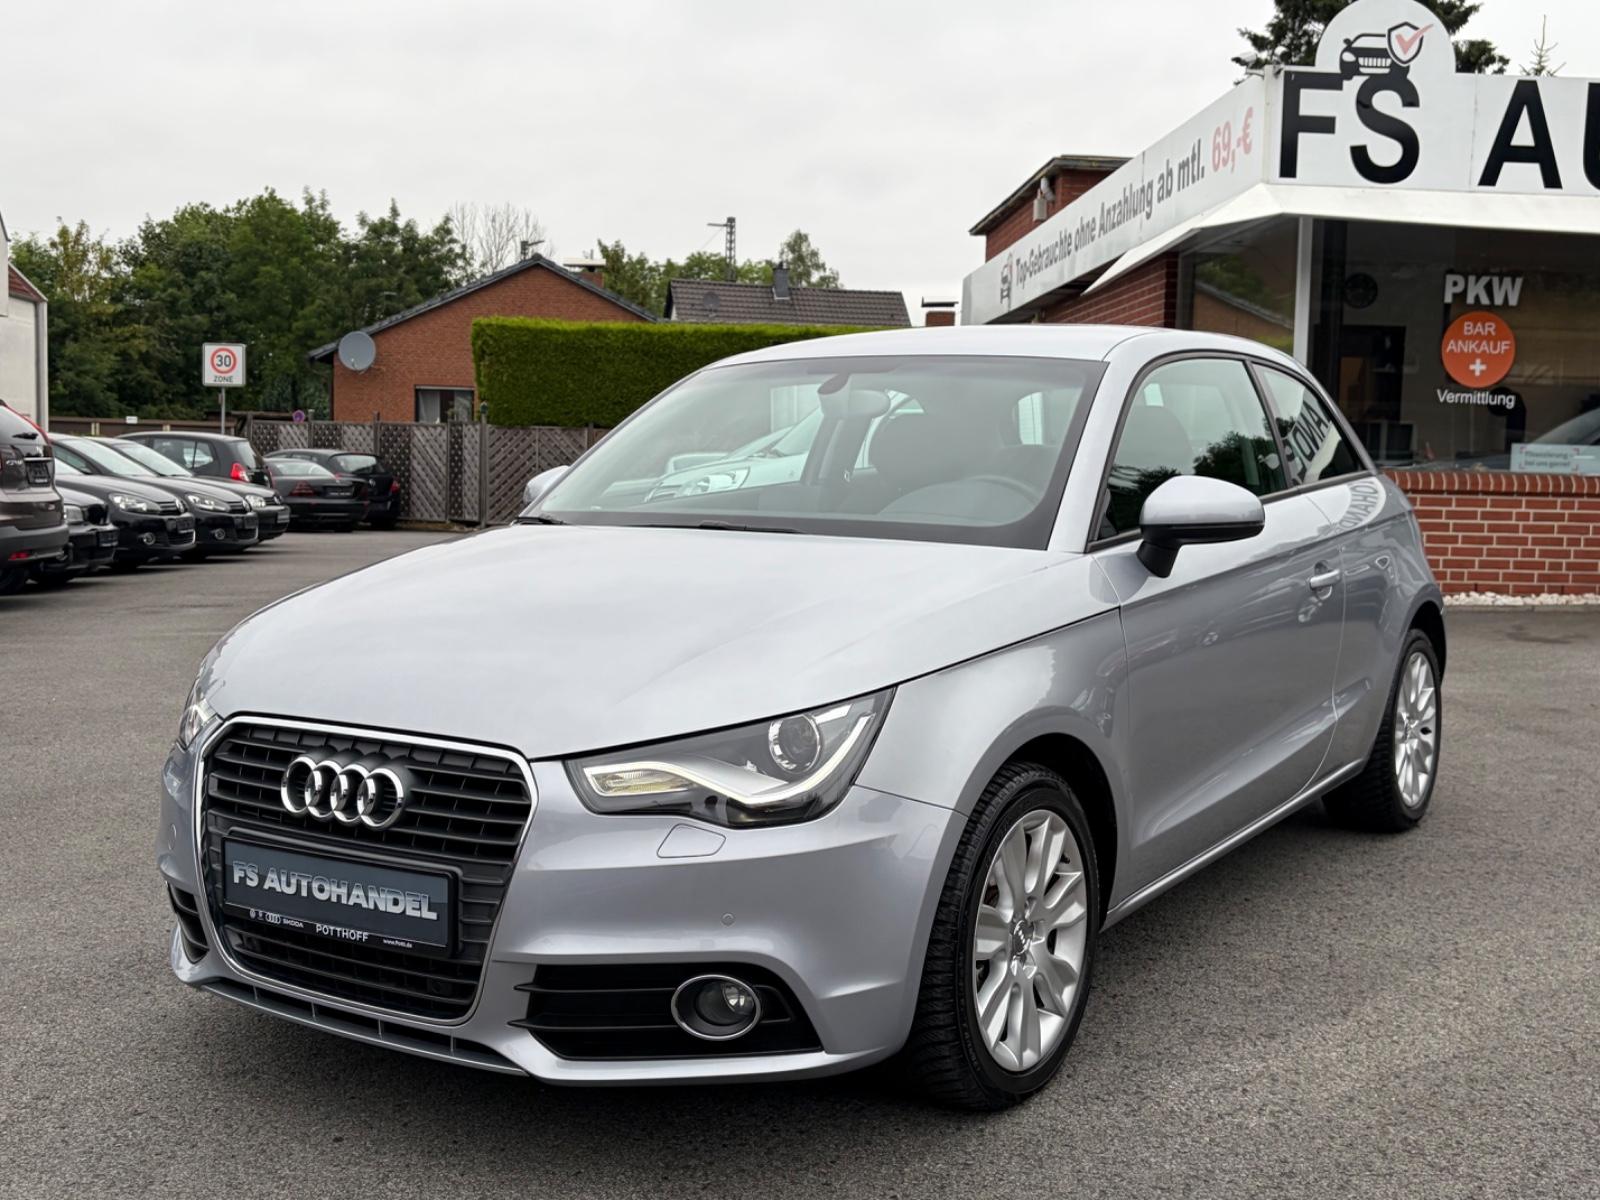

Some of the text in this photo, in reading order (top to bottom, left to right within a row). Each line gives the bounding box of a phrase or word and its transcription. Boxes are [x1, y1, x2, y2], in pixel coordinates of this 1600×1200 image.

[1279, 70, 1600, 191] FS A
[1015, 228, 1072, 289] Top-Gebrauchte
[1074, 216, 1097, 252] ohne
[1098, 180, 1154, 239] Anzahlung
[1157, 158, 1174, 204] ab
[1177, 138, 1205, 192] mtl.
[1443, 273, 1523, 307] PKW
[1463, 321, 1496, 336] BAR
[1446, 339, 1512, 355] ANKAUF
[215, 354, 232, 367] 30
[213, 375, 234, 383] ZONE
[1436, 388, 1516, 410] Vermittlung
[232, 860, 438, 921] FS AUTOHANDEL
[315, 923, 369, 942] POTTHOFF
